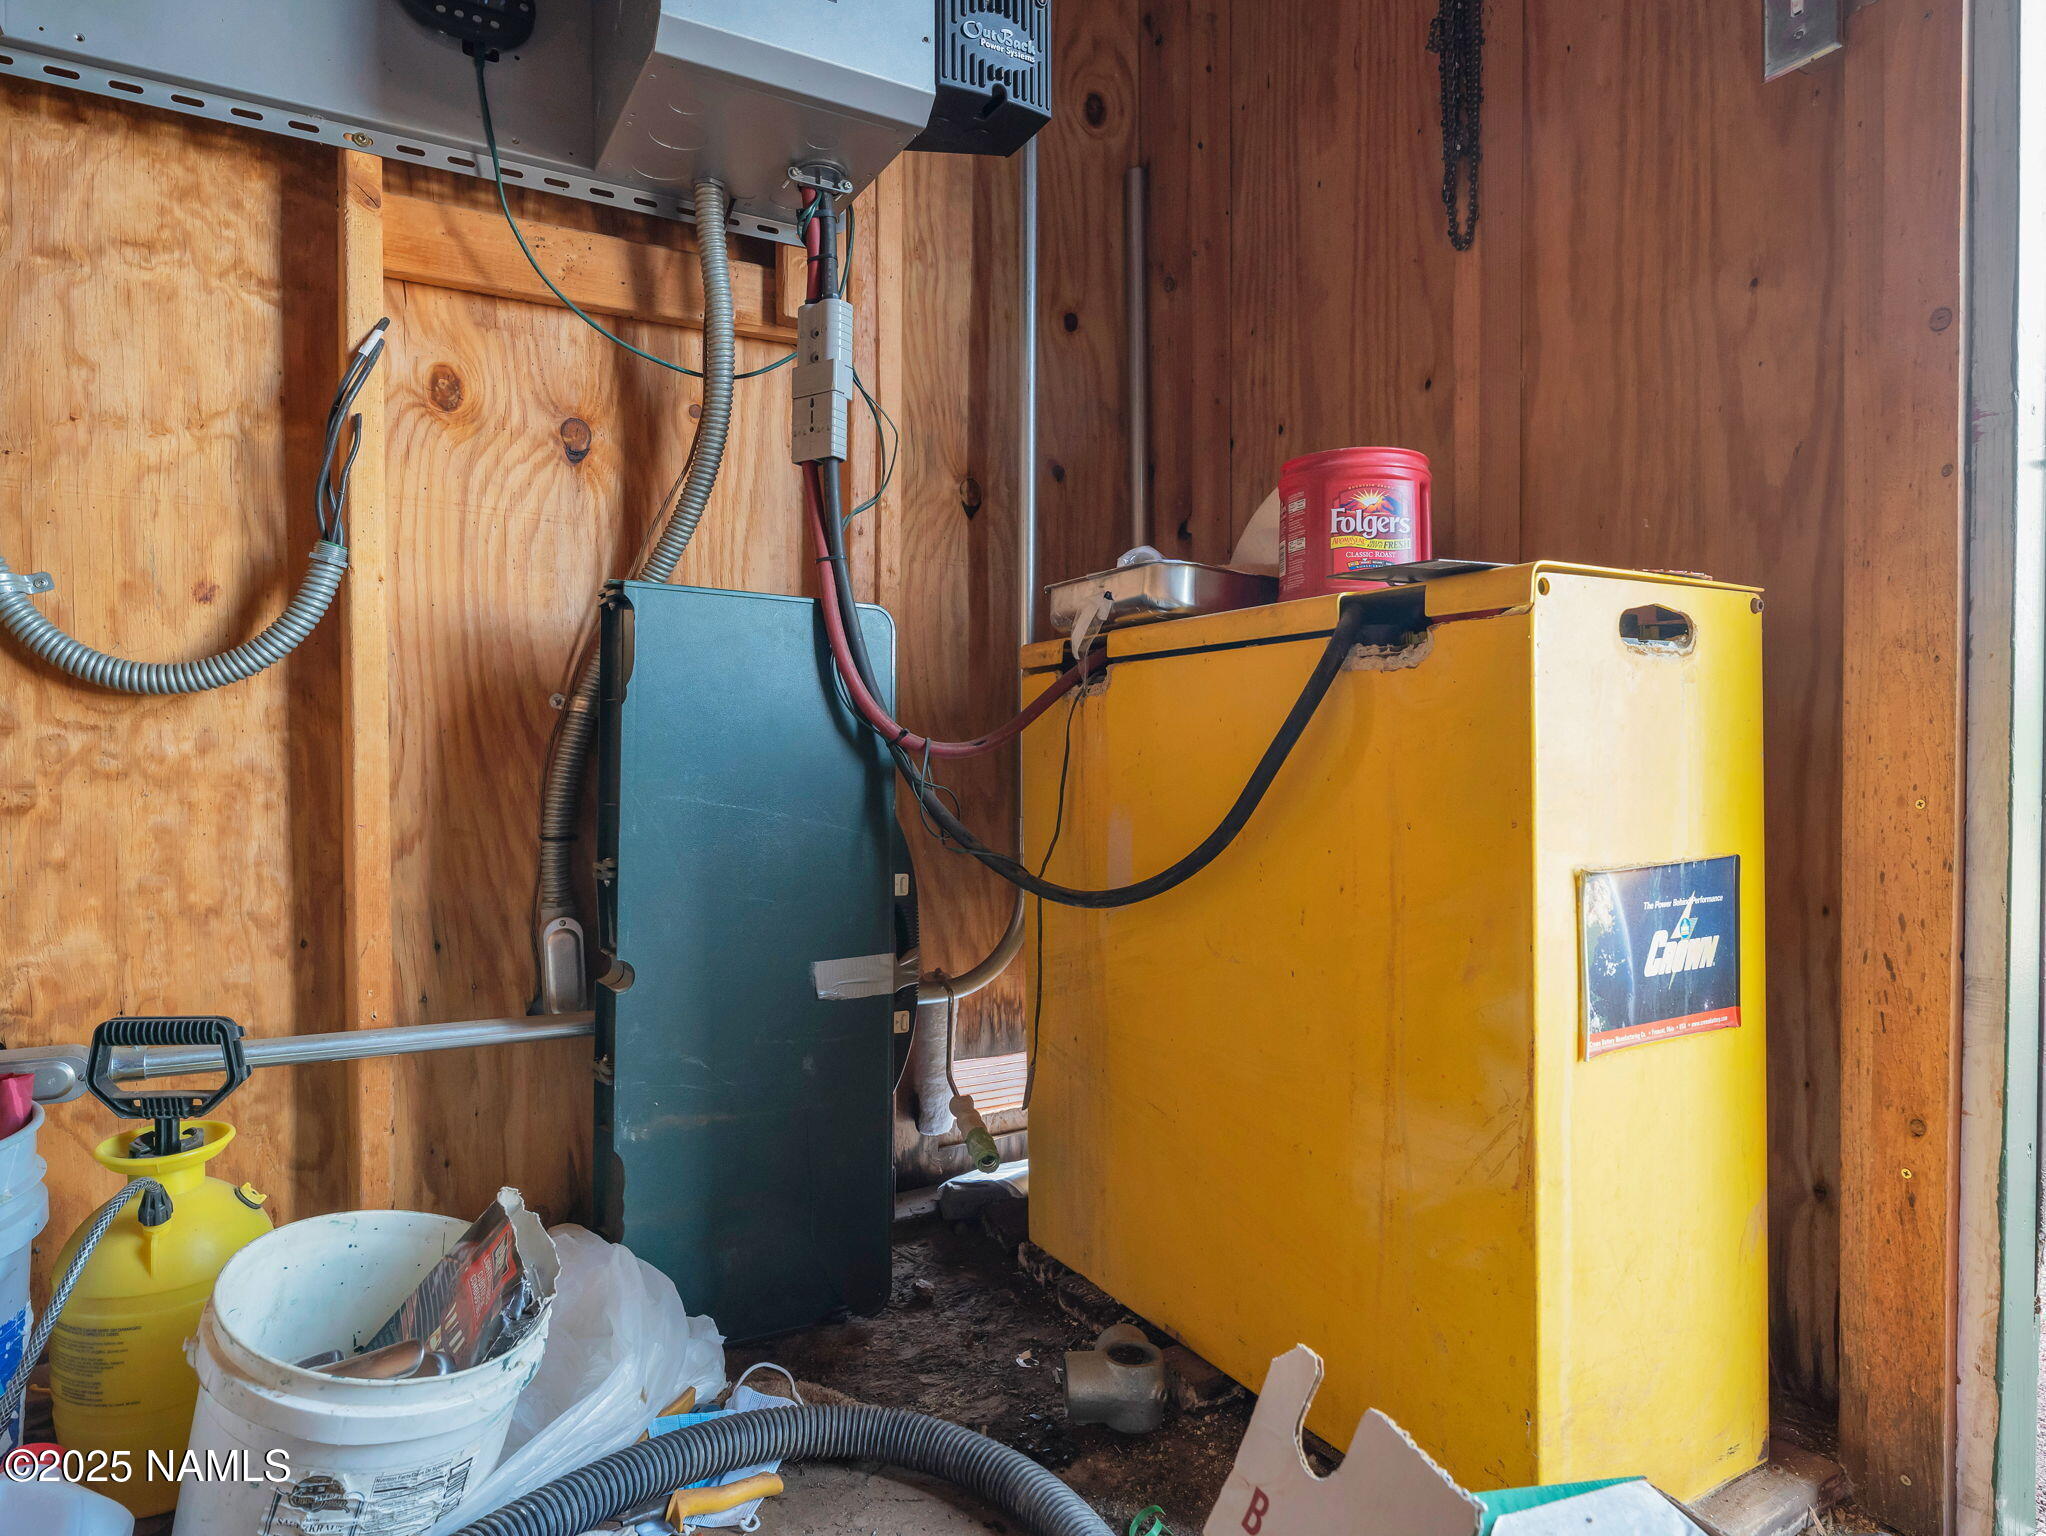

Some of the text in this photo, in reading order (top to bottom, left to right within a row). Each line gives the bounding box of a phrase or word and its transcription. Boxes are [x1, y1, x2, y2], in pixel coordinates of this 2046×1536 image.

[962, 20, 1036, 55] OutBack
[980, 37, 1036, 63] Power Systems
[1330, 507, 1411, 539] Folgers
[1383, 540, 1410, 549] FRESH
[1643, 901, 1654, 910] The
[1655, 900, 1672, 909] Power
[1691, 895, 1724, 905] Performance
[1644, 929, 1719, 977] CROWN
[1241, 1486, 1269, 1535] B
